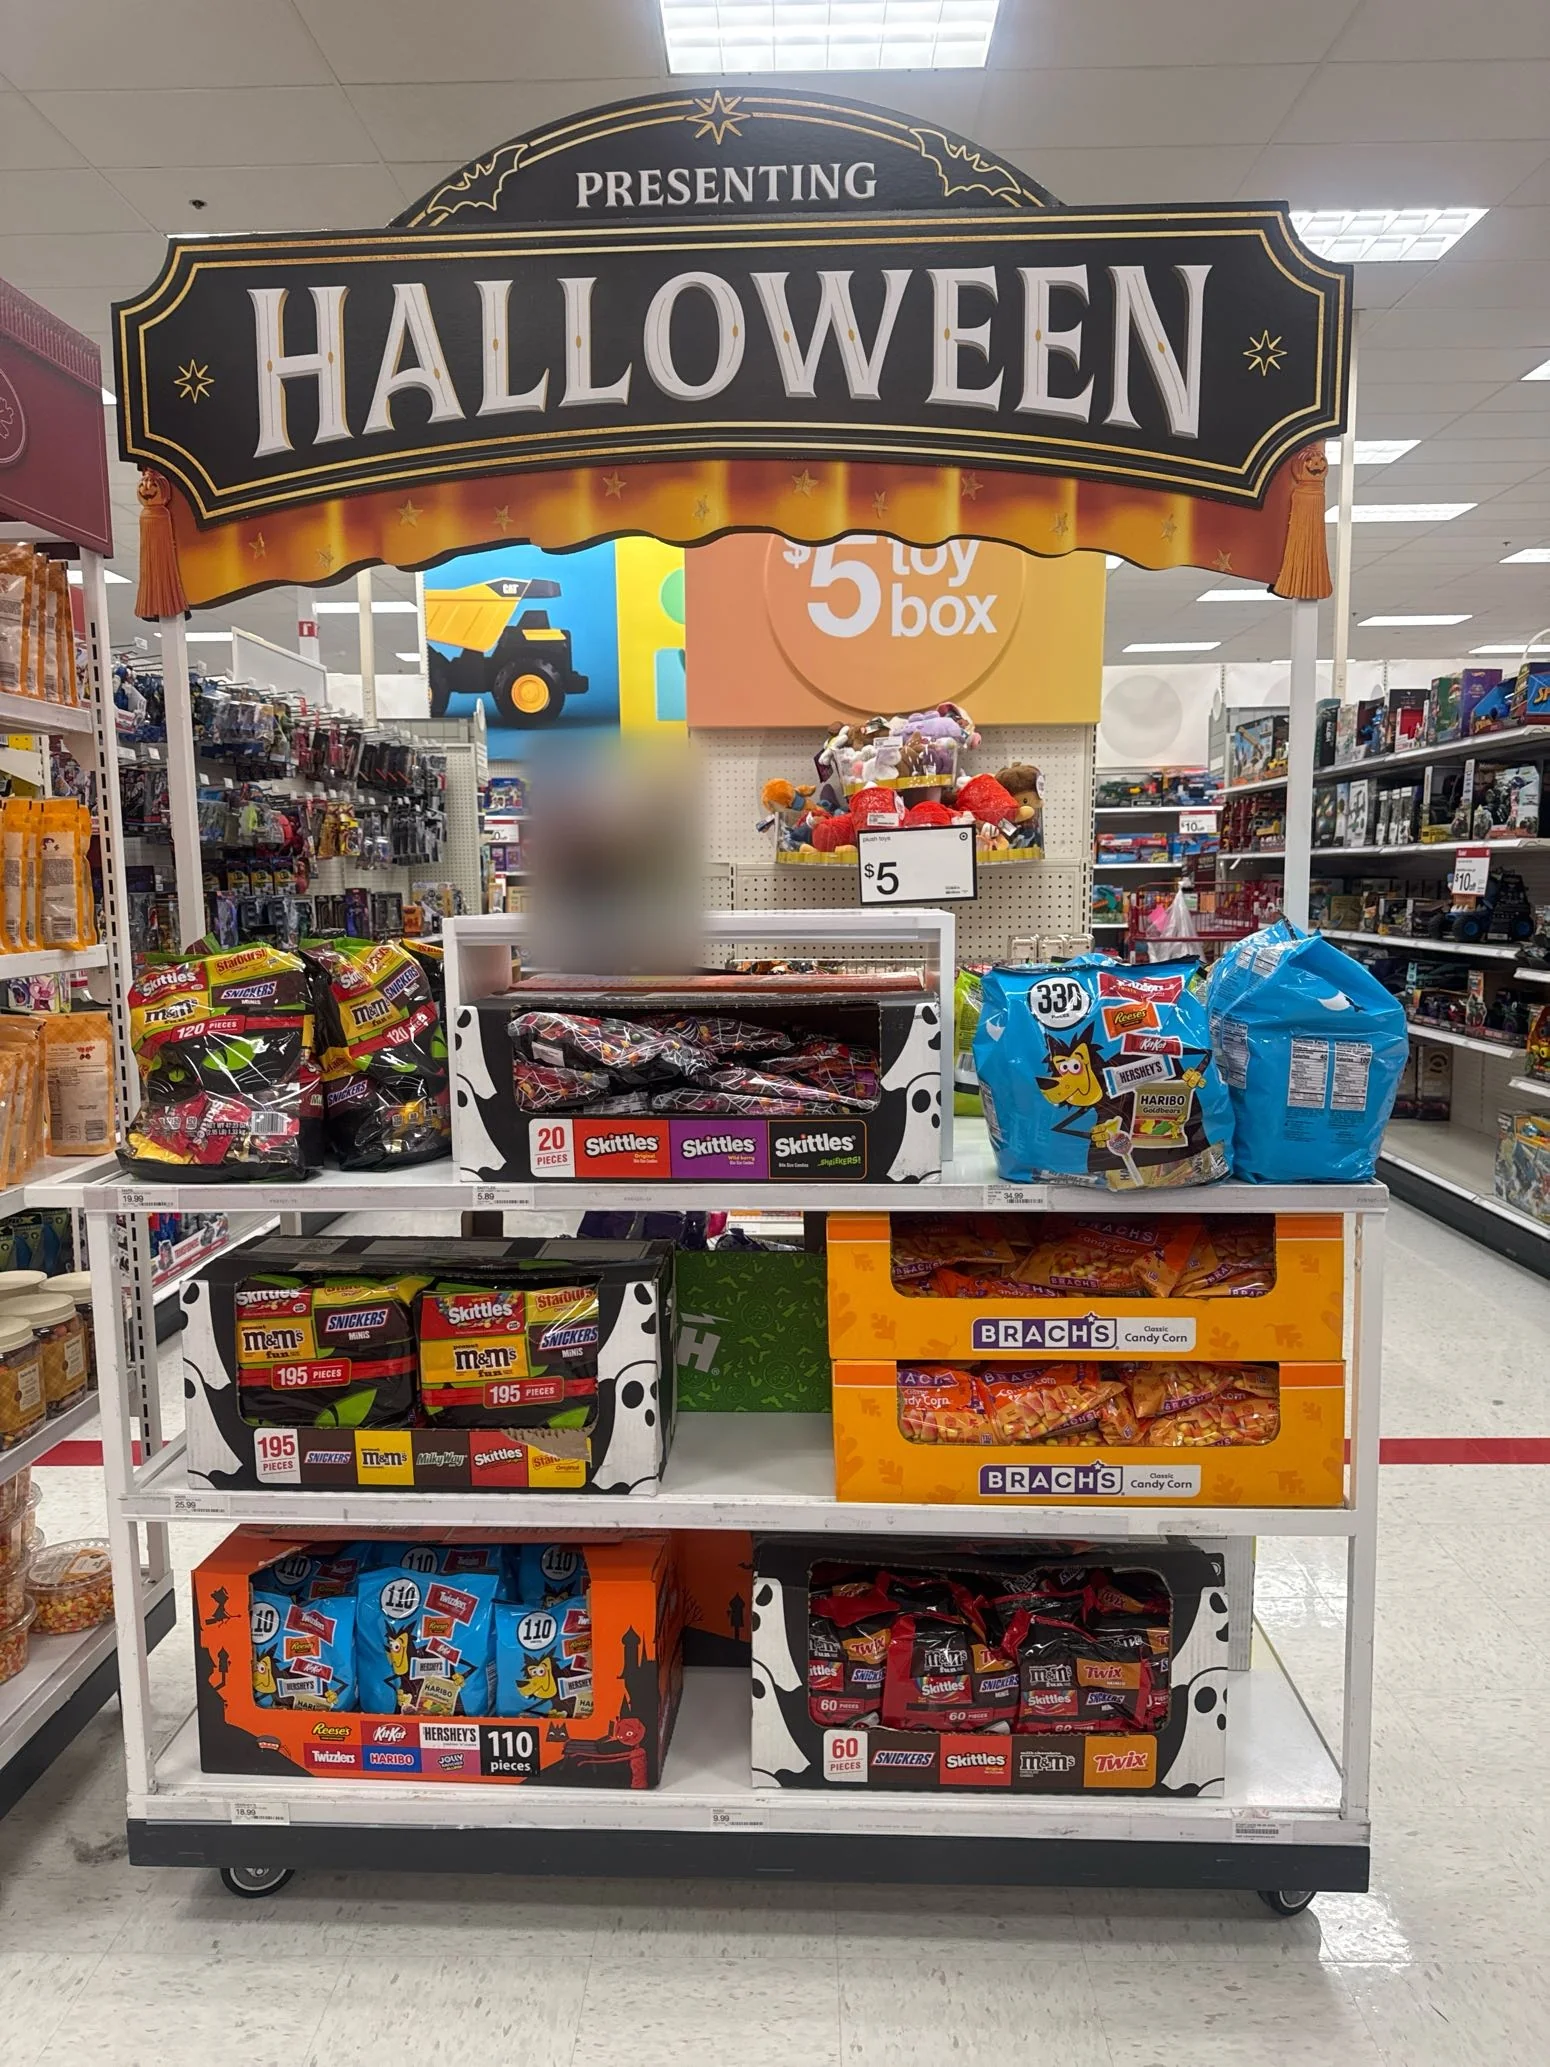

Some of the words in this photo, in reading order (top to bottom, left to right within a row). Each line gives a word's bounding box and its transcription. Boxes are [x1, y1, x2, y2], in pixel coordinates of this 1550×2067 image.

[576, 162, 878, 209] PRESENTING
[247, 264, 1214, 460] HALLOWEEN
[886, 537, 981, 588] toy
[502, 583, 519, 595] CAT
[891, 583, 998, 638] box
[864, 862, 899, 895] $5
[216, 948, 267, 972] Starburst
[142, 970, 197, 998] Skittles
[222, 982, 275, 999] SNICKERS
[384, 965, 421, 1000] SNICKERS
[1037, 982, 1082, 1014] 330
[177, 1023, 205, 1040] 120
[208, 1021, 237, 1030] PIECES
[386, 1027, 410, 1045] 120
[1119, 1061, 1163, 1084] HERSHEY'S
[327, 1080, 369, 1108] SNICKERS
[1140, 1095, 1185, 1106] HARIBO
[538, 1126, 566, 1151] 20
[585, 1133, 659, 1157] Skittles
[682, 1135, 757, 1158] Skittles
[775, 1132, 857, 1157] Skittles
[537, 1154, 569, 1166] PIECES
[123, 1195, 144, 1203] 19.99
[477, 1192, 495, 1201] 5.89
[1003, 1192, 1024, 1200] 34.99
[327, 1310, 387, 1331] SNICKERS
[448, 1301, 513, 1324] Skittles
[542, 1327, 598, 1349] SNICKERS
[1124, 1333, 1160, 1345] Candy
[1162, 1333, 1188, 1342] Corn
[266, 1350, 290, 1359] fun
[276, 1366, 309, 1386] 195
[312, 1368, 342, 1379] PIECES
[478, 1369, 503, 1378] fun
[489, 1384, 521, 1405] 195
[525, 1387, 555, 1397] PIECES
[257, 1434, 296, 1459] 195
[263, 1460, 294, 1472] PIECES
[306, 1451, 351, 1464] SNICKERS
[474, 1448, 523, 1466] Skittles
[1130, 1480, 1166, 1490] Candy
[1167, 1480, 1193, 1489] Corn
[175, 1501, 197, 1509] 25.99
[407, 1553, 434, 1573] 110
[385, 1584, 416, 1609] 110
[439, 1591, 467, 1612] Twizzlers
[253, 1609, 274, 1633] 10
[523, 1619, 552, 1641] 110
[851, 1637, 886, 1656] Twix
[810, 1664, 838, 1677] ittles
[1085, 1664, 1122, 1679] Twix
[424, 1683, 453, 1698] HARIBO
[921, 1681, 965, 1696] Skittles
[981, 1675, 1019, 1691] SNICKERS
[820, 1699, 838, 1711] 60
[1028, 1692, 1072, 1706] Skittles
[948, 1711, 966, 1720] 60
[422, 1727, 477, 1743] HERSHEY'S
[487, 1730, 534, 1758] 110
[312, 1750, 356, 1764] Twizzlers
[832, 1737, 859, 1759] 60
[370, 1753, 414, 1765] HARIBO
[438, 1754, 464, 1765] JOLLY
[490, 1759, 531, 1773] pieces
[830, 1761, 861, 1772] PIECES
[875, 1751, 933, 1766] SNICKERS
[946, 1752, 1006, 1768] Skittles
[1093, 1750, 1148, 1773] Twix
[236, 1808, 256, 1816] 18.99
[713, 1814, 730, 1822] 9.99
